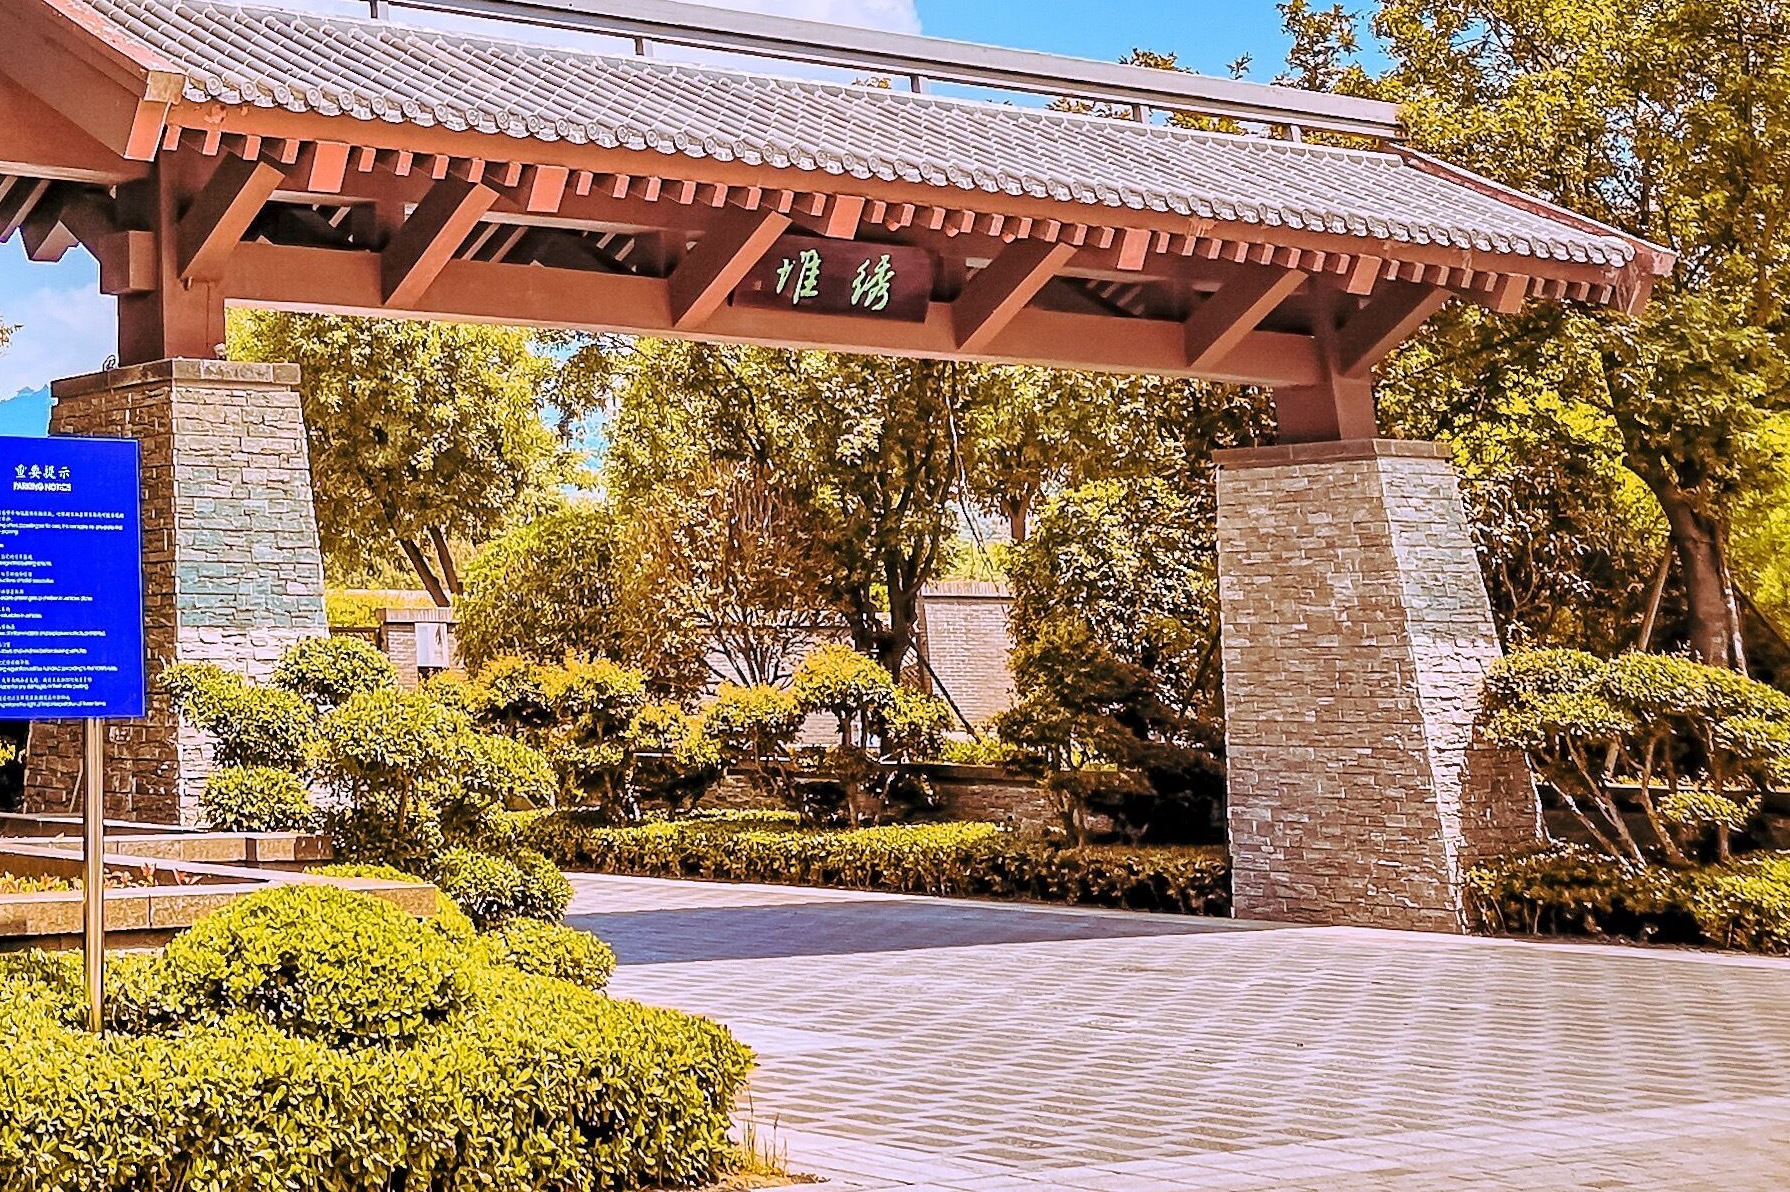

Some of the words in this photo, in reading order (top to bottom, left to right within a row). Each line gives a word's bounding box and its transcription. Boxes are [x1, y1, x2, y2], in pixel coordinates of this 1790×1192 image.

[15, 464, 70, 479] 重要提示
[13, 481, 44, 491] PARKING
